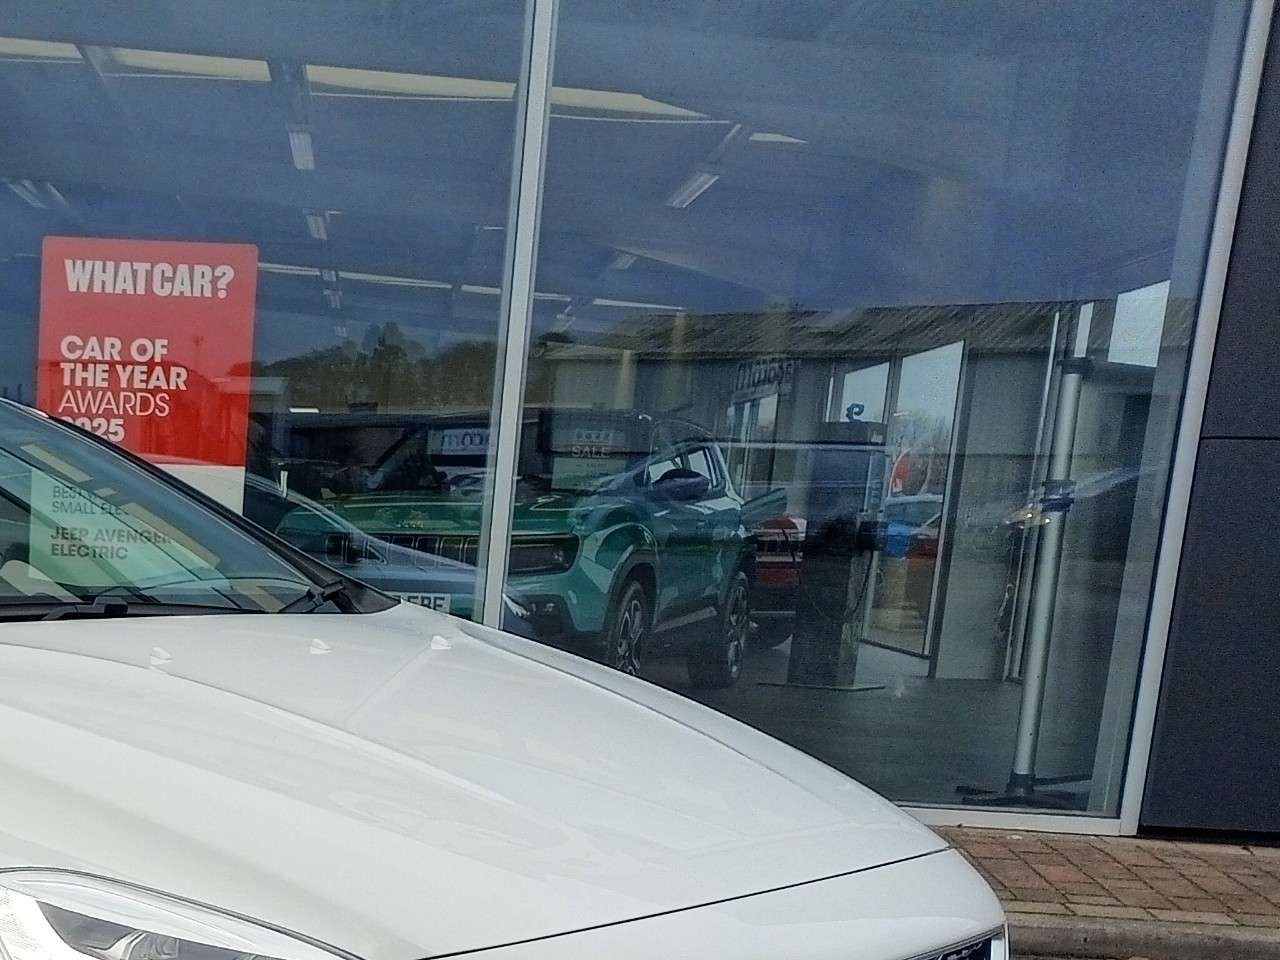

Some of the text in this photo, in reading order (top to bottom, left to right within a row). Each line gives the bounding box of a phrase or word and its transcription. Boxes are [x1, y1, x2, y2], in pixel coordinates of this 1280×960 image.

[60, 335, 169, 362] CAR OF
[60, 362, 188, 391] THE YEAR
[58, 390, 170, 417] AWARDS
[52, 501, 96, 515] SMALL
[51, 526, 88, 541] JEEP
[51, 543, 128, 560] ELECTRIC
